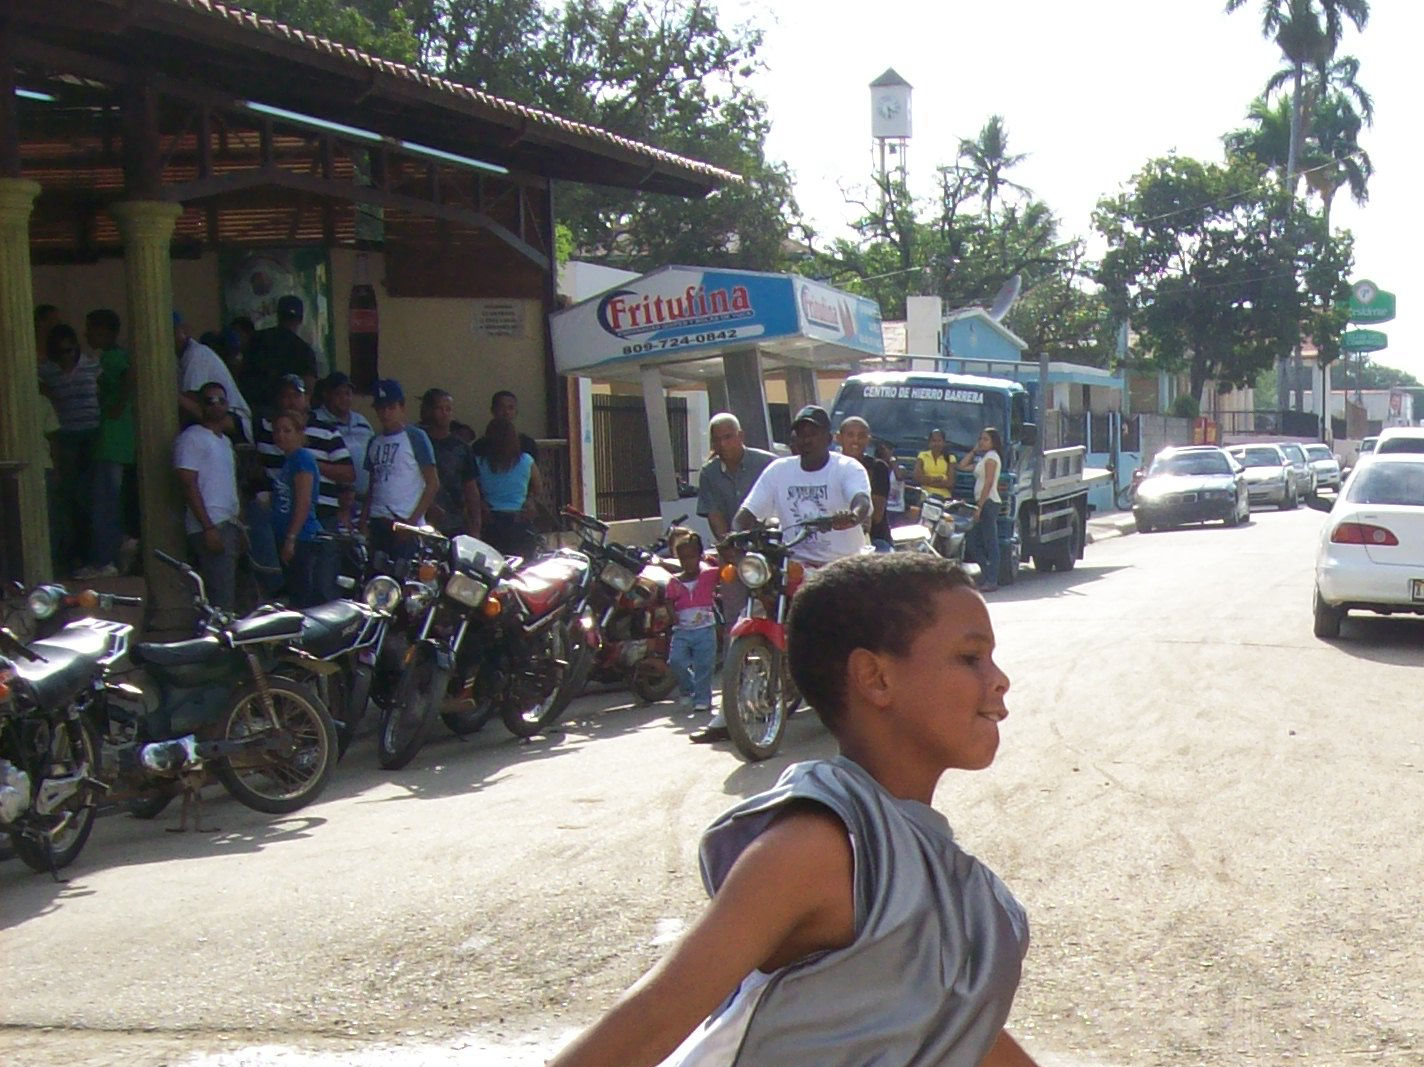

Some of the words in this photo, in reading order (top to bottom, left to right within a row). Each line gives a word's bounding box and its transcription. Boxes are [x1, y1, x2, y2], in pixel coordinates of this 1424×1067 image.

[608, 285, 751, 330] Fritufina
[622, 329, 737, 355] 809-724-0842
[863, 386, 897, 399] CENTRO
[898, 387, 910, 399] DE
[911, 388, 943, 400] HIERRO
[944, 389, 984, 404] BARRERA
